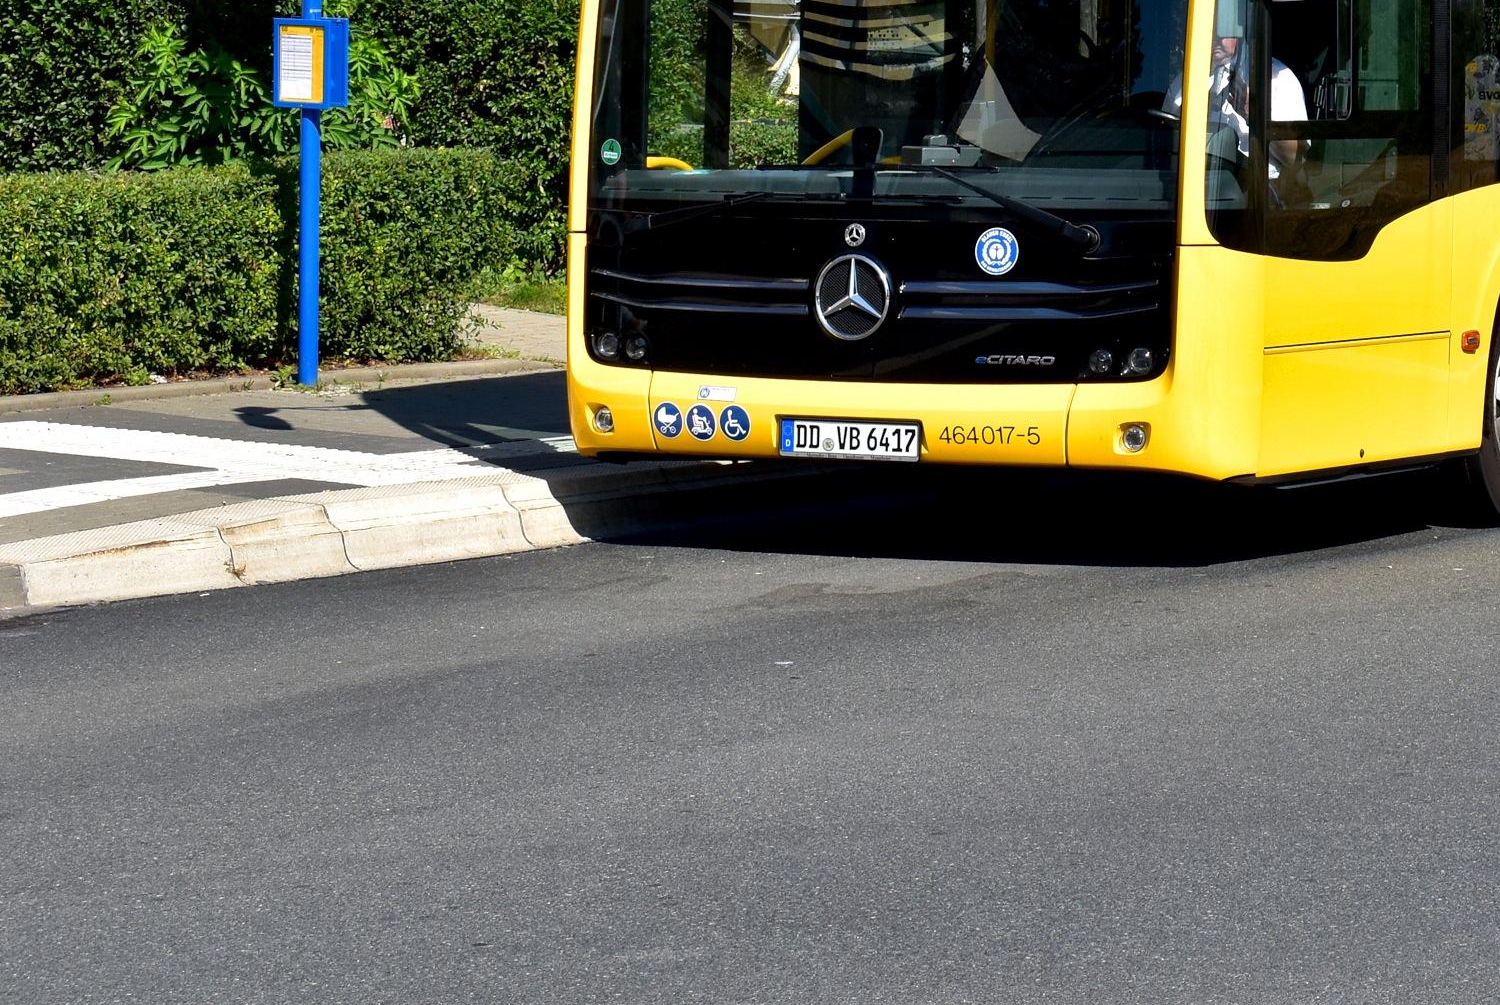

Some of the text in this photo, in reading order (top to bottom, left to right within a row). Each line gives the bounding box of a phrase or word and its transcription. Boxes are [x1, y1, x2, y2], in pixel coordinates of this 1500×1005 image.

[975, 355, 1056, 365] eCITARO
[785, 439, 790, 447] D
[796, 424, 916, 453] DD VB 6417
